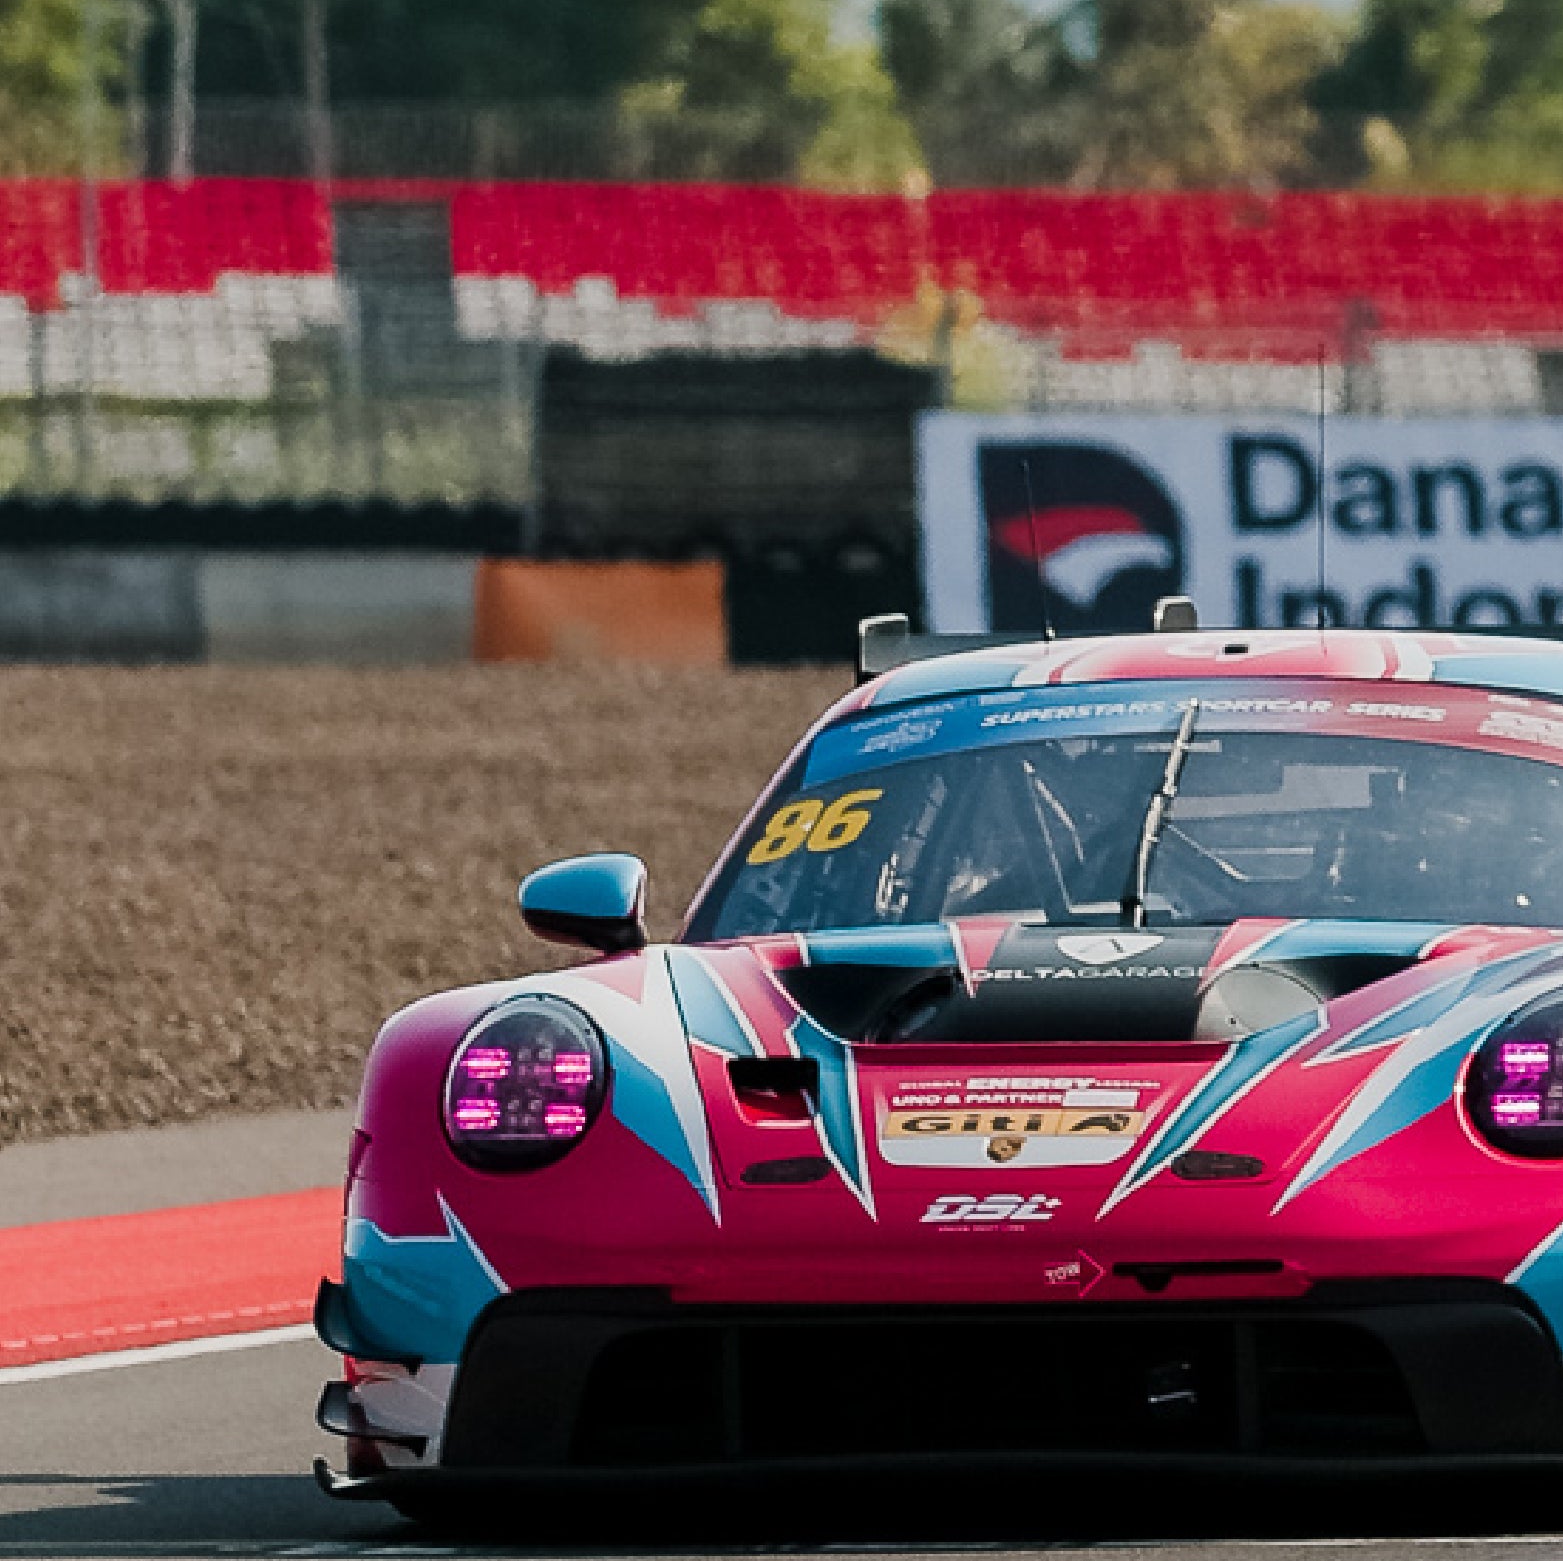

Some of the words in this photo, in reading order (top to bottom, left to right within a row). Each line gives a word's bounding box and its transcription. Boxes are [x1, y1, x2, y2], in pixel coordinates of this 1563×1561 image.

[981, 700, 1165, 727] SUPERSTARS
[1346, 702, 1447, 723] SERIES
[746, 789, 885, 865] 86
[901, 1114, 1043, 1133] Giti
